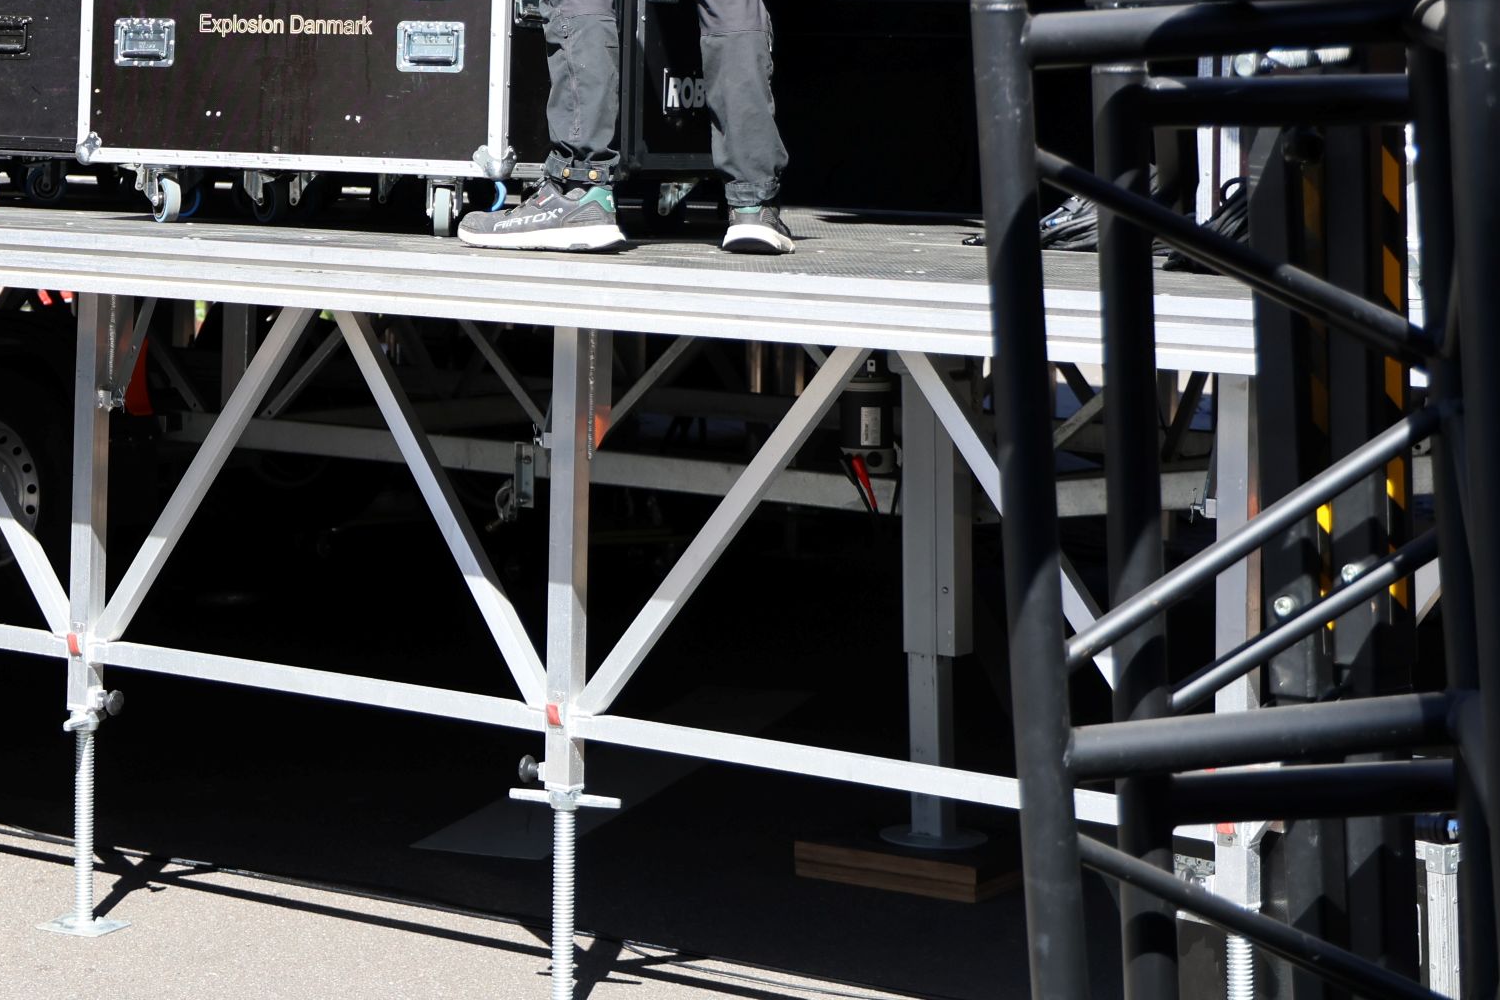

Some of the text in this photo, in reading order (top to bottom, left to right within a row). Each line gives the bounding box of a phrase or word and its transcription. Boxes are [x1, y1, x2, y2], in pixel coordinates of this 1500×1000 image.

[199, 14, 373, 37] Explosion Danmark
[667, 76, 705, 109] ROB
[493, 208, 559, 231] AIRTOX
